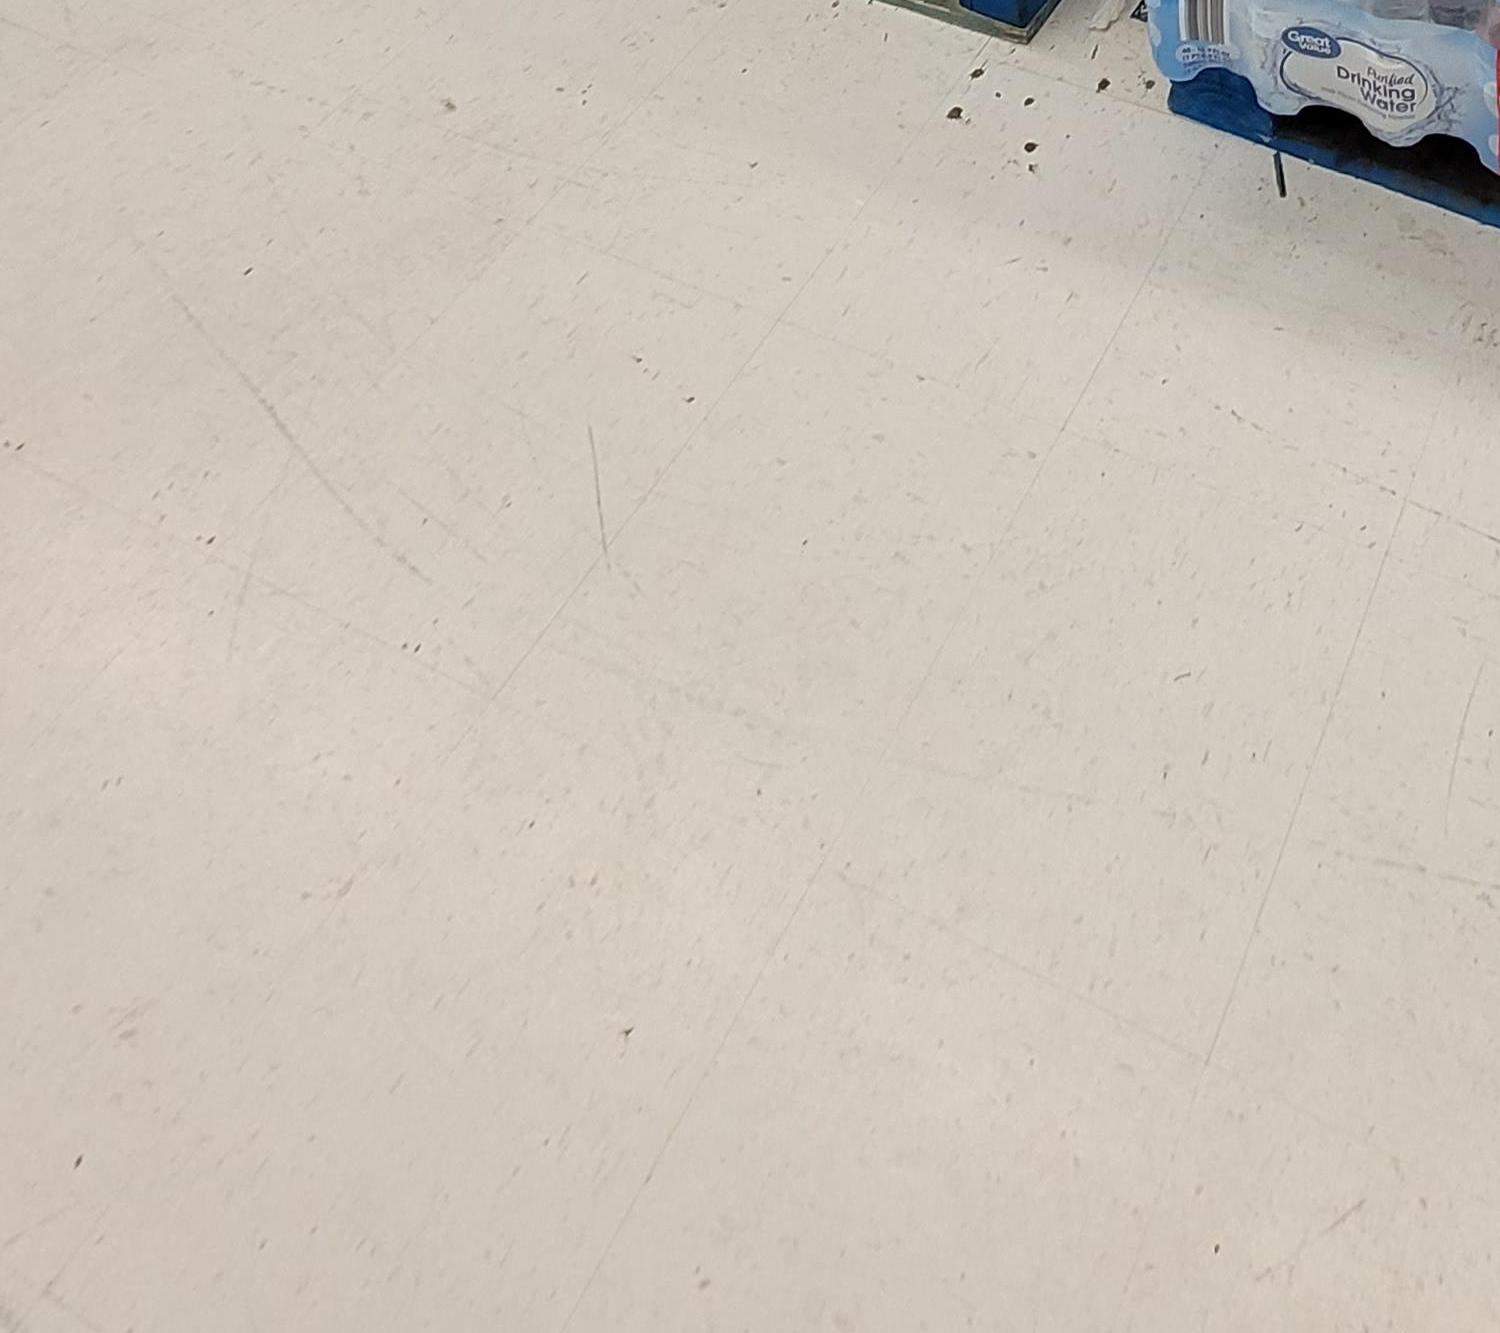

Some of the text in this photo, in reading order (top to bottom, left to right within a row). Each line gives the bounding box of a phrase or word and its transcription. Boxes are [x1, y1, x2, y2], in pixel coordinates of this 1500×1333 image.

[1287, 31, 1331, 51] Great
[1336, 65, 1416, 102] Drinking
[1360, 87, 1418, 113] Water
